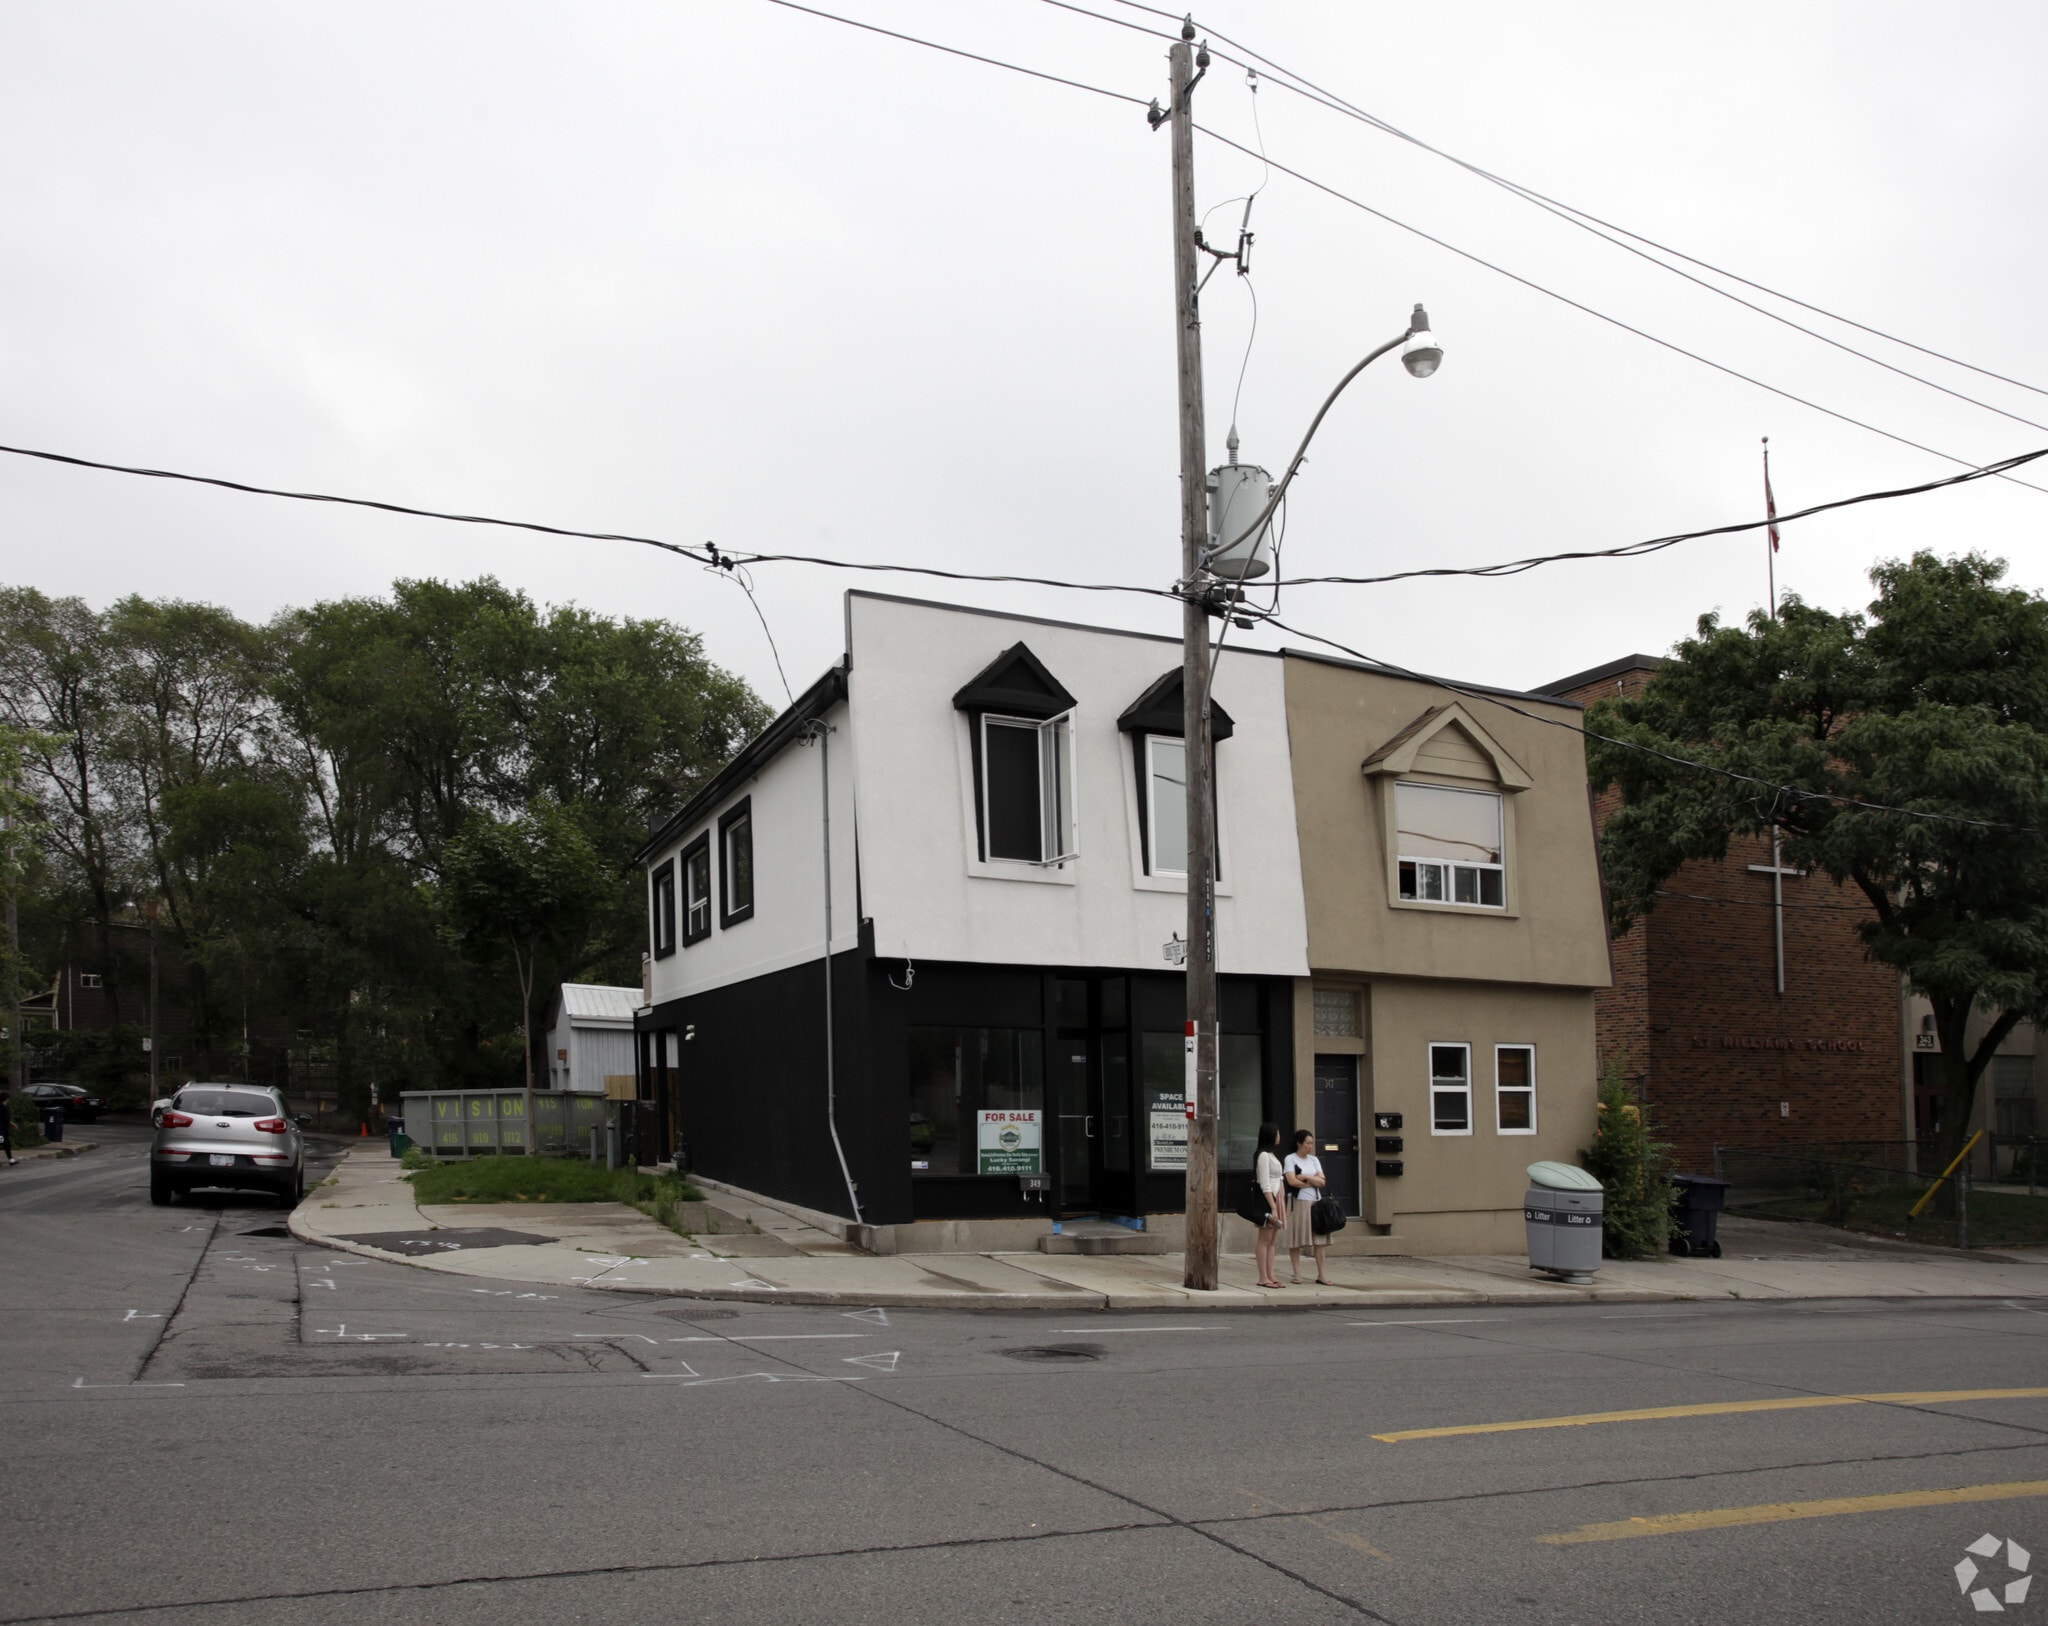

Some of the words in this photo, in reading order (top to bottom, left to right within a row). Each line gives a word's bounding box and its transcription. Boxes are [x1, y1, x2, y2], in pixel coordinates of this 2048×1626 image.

[1807, 1039, 1866, 1052] SCHOOL
[1159, 1093, 1183, 1101] SPACE
[1152, 1102, 1186, 1110] AVAILABL
[985, 1113, 1005, 1122] FOR
[1009, 1113, 1034, 1122] SALE
[443, 1132, 458, 1144] 416
[473, 1132, 489, 1144] 919
[503, 1131, 521, 1144] 1112
[1030, 1179, 1041, 1188] 349
[1534, 1211, 1551, 1221] Litter
[1567, 1214, 1585, 1224] Litter
